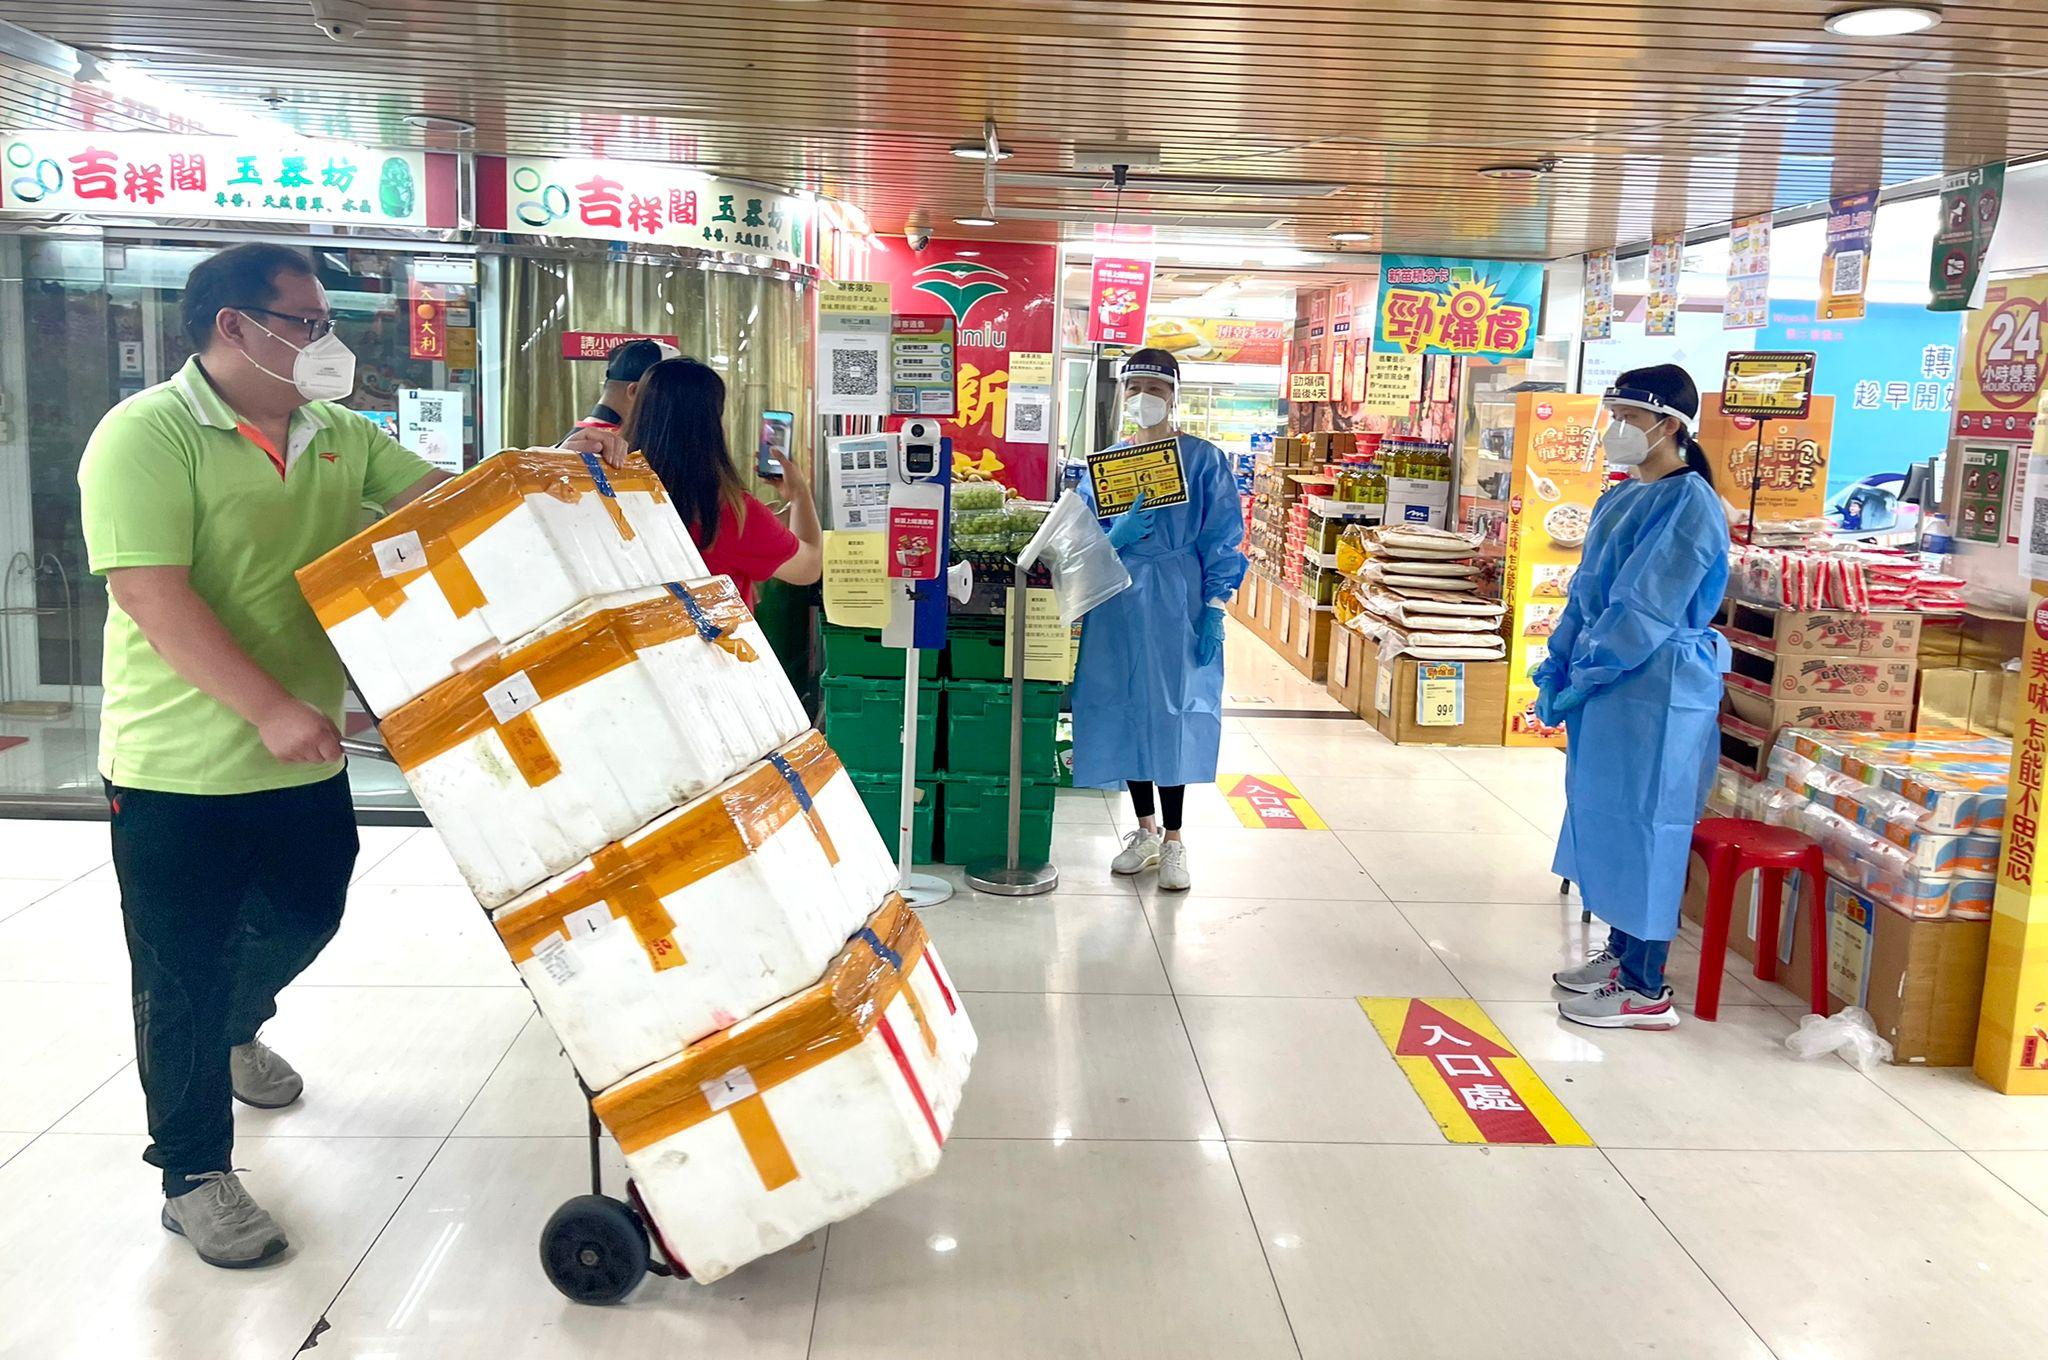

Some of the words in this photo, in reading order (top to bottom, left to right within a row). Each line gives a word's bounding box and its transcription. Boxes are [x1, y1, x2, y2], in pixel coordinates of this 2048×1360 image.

[68, 146, 206, 204] 吉祥閣
[575, 174, 697, 234] 吉祥閣
[1388, 268, 1449, 283] 新苗積分卡
[1388, 292, 1523, 350] 勁爆價
[1988, 308, 2040, 360] 24
[1923, 346, 1957, 378] 轉
[1982, 364, 2037, 383] 小時營業
[1293, 389, 1326, 398] 最後4天
[1294, 376, 1324, 386] 勁爆價
[1982, 381, 2010, 393] HOURS
[2011, 381, 2036, 393] OPEN
[1246, 784, 1294, 820] 入口處
[1420, 1025, 1525, 1111] 入口處
